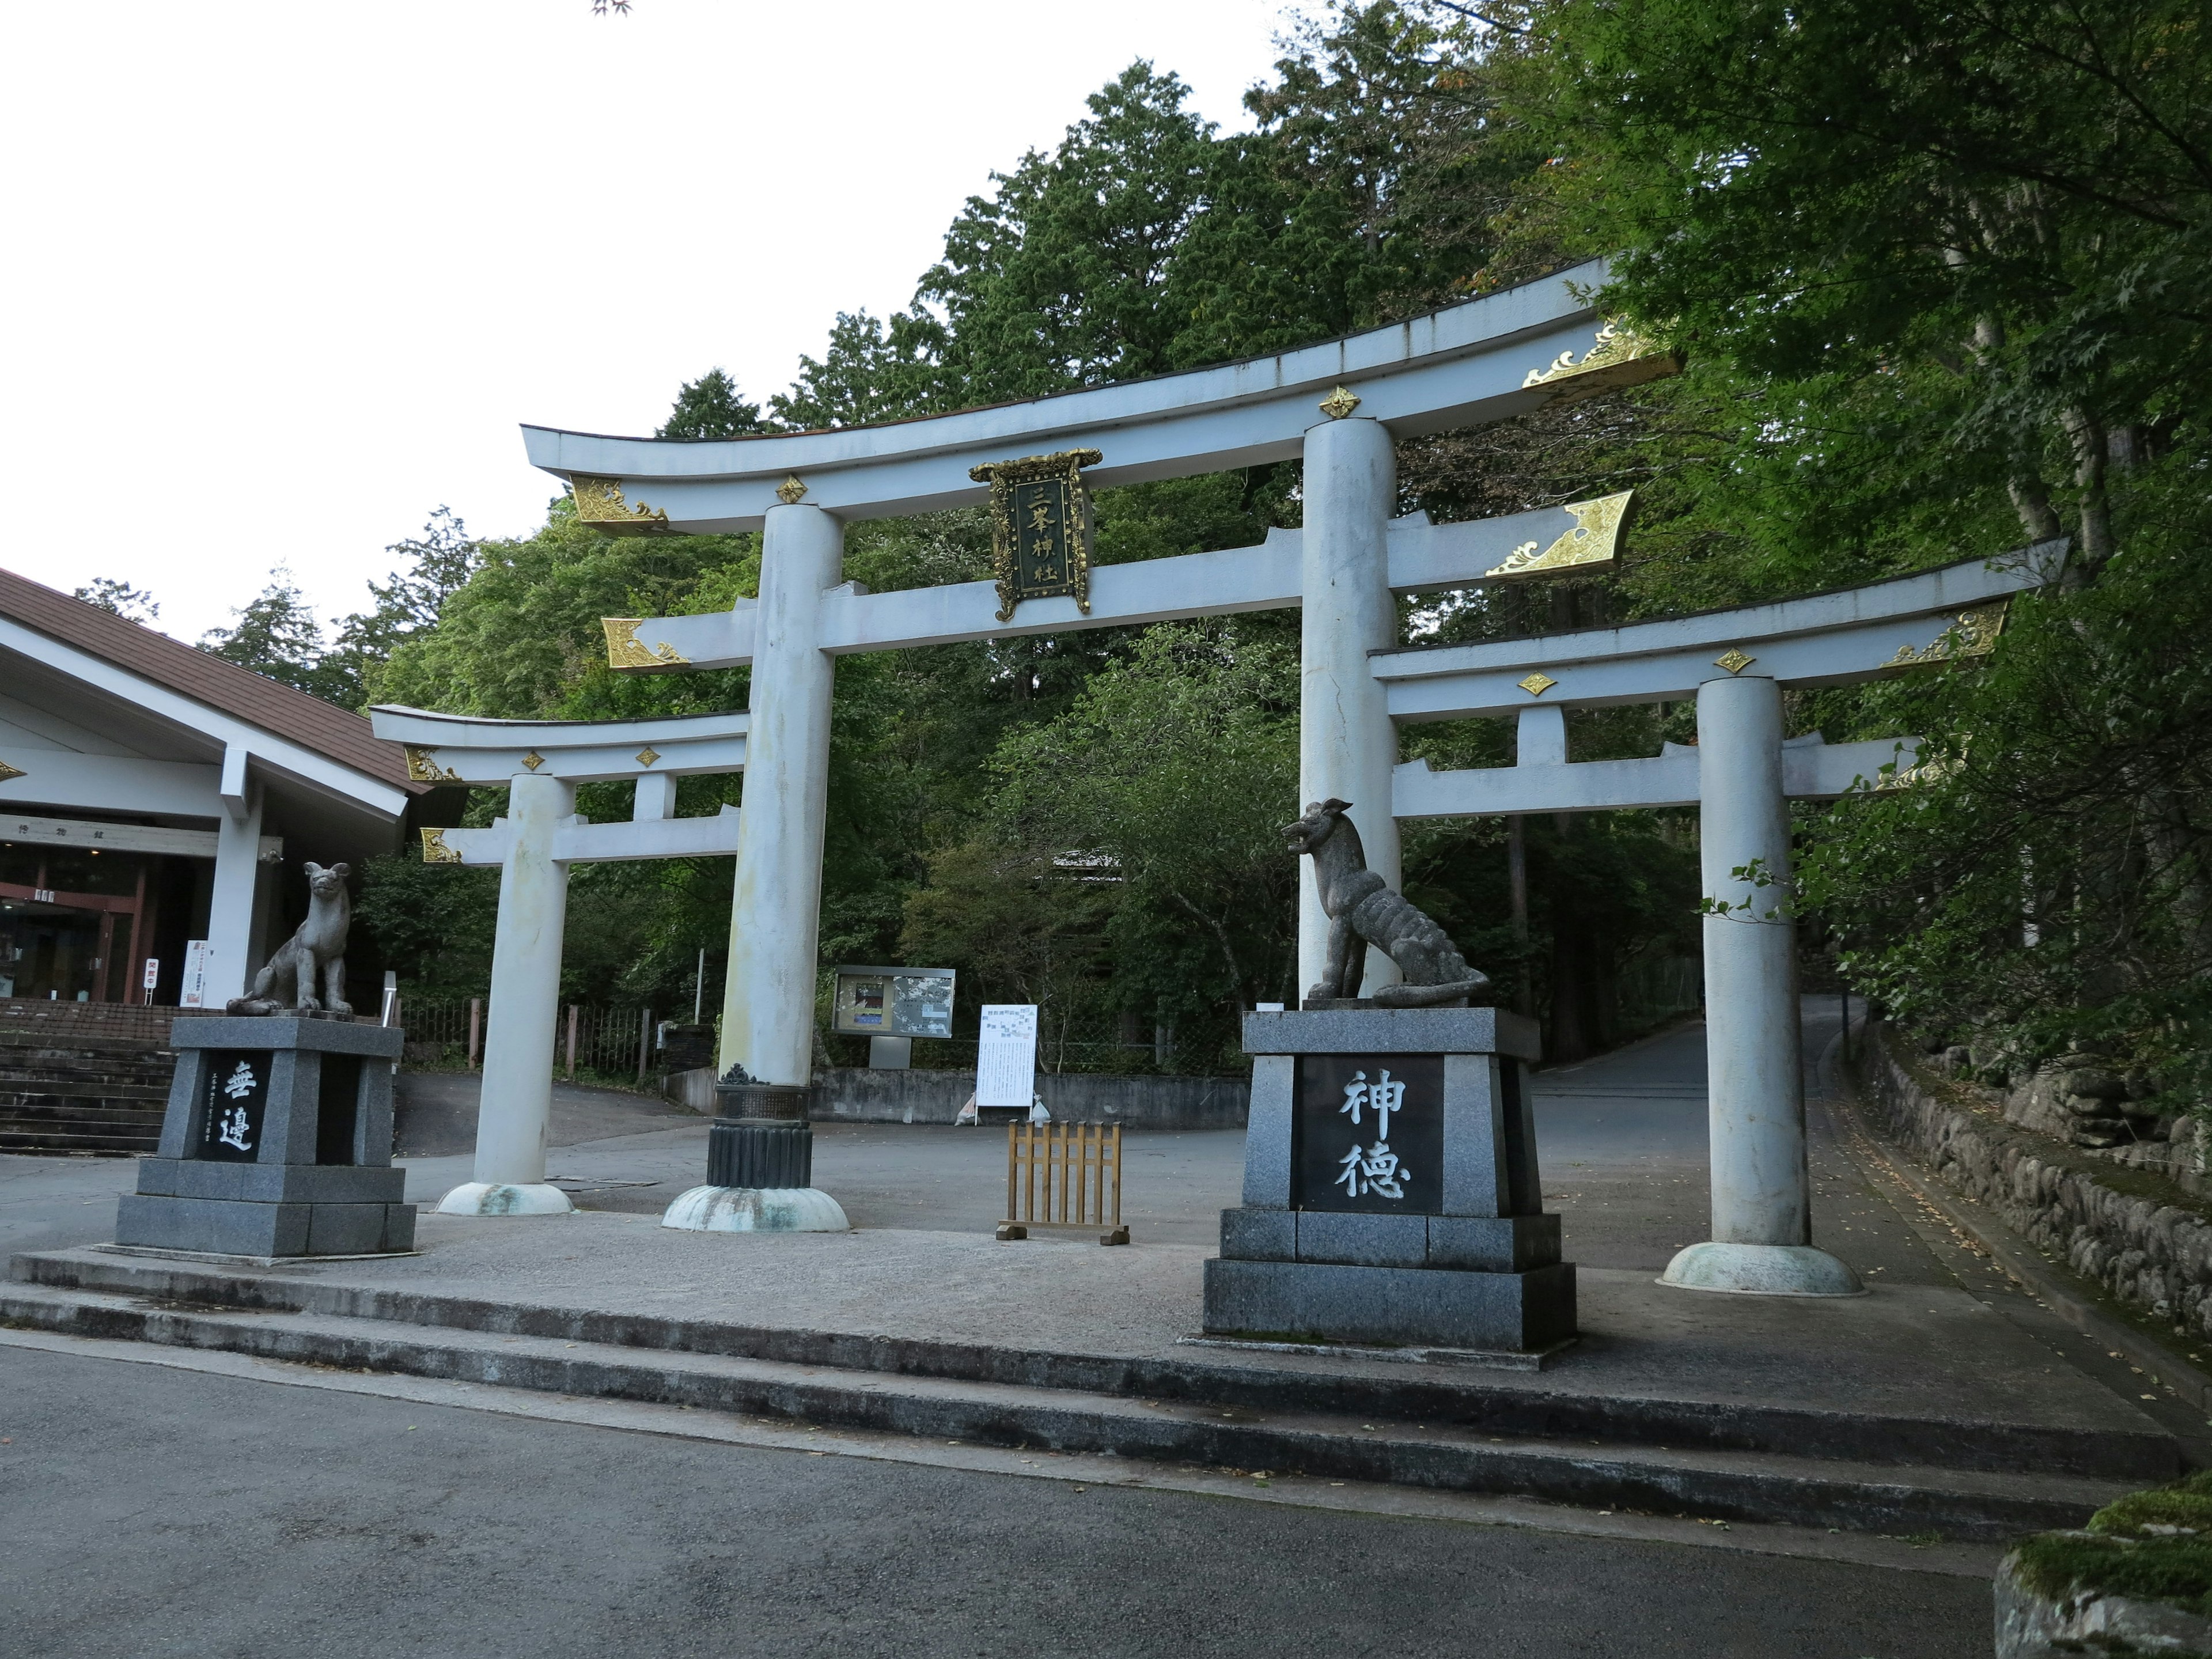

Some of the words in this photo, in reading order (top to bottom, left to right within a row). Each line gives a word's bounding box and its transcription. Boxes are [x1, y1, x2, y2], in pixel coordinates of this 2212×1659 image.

[1028, 487, 1058, 582] 三峯神社
[147, 962, 156, 984] 開館中
